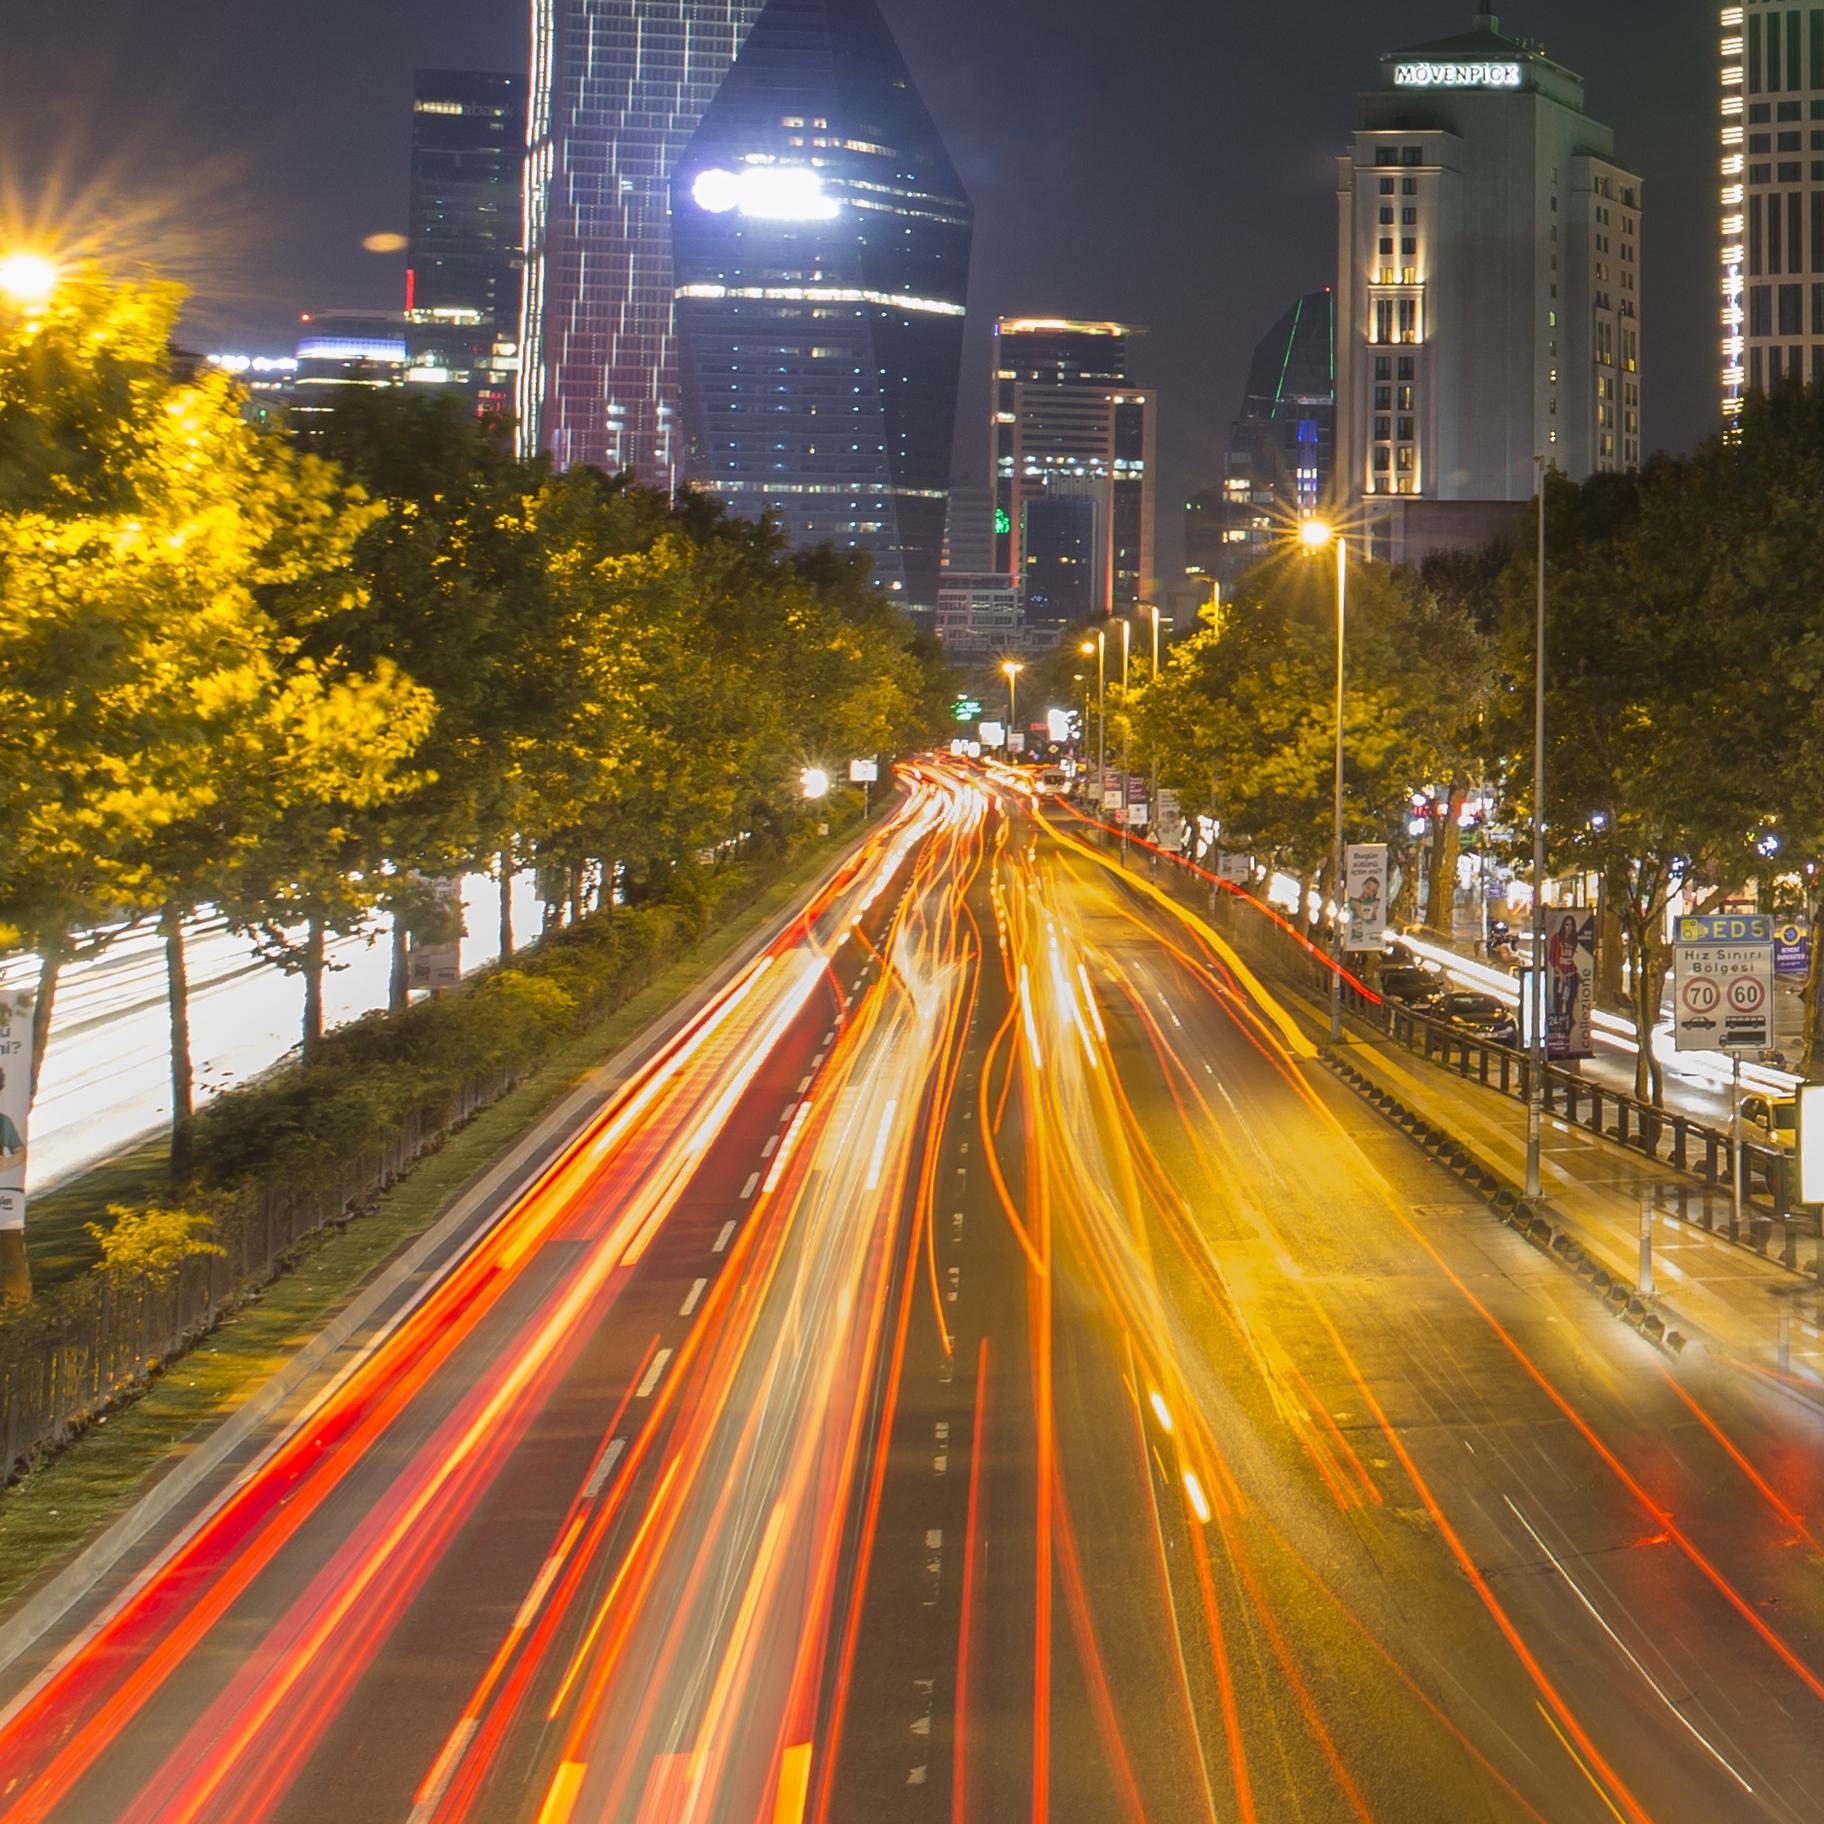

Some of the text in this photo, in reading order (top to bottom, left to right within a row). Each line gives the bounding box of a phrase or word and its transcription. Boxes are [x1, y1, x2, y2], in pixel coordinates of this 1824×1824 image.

[1712, 919, 1765, 939] EDS
[1684, 949, 1762, 961] Hız Sınırı
[1693, 962, 1754, 975] Bölgesi
[1690, 987, 1713, 1005] 70
[1734, 985, 1758, 1003] 60
